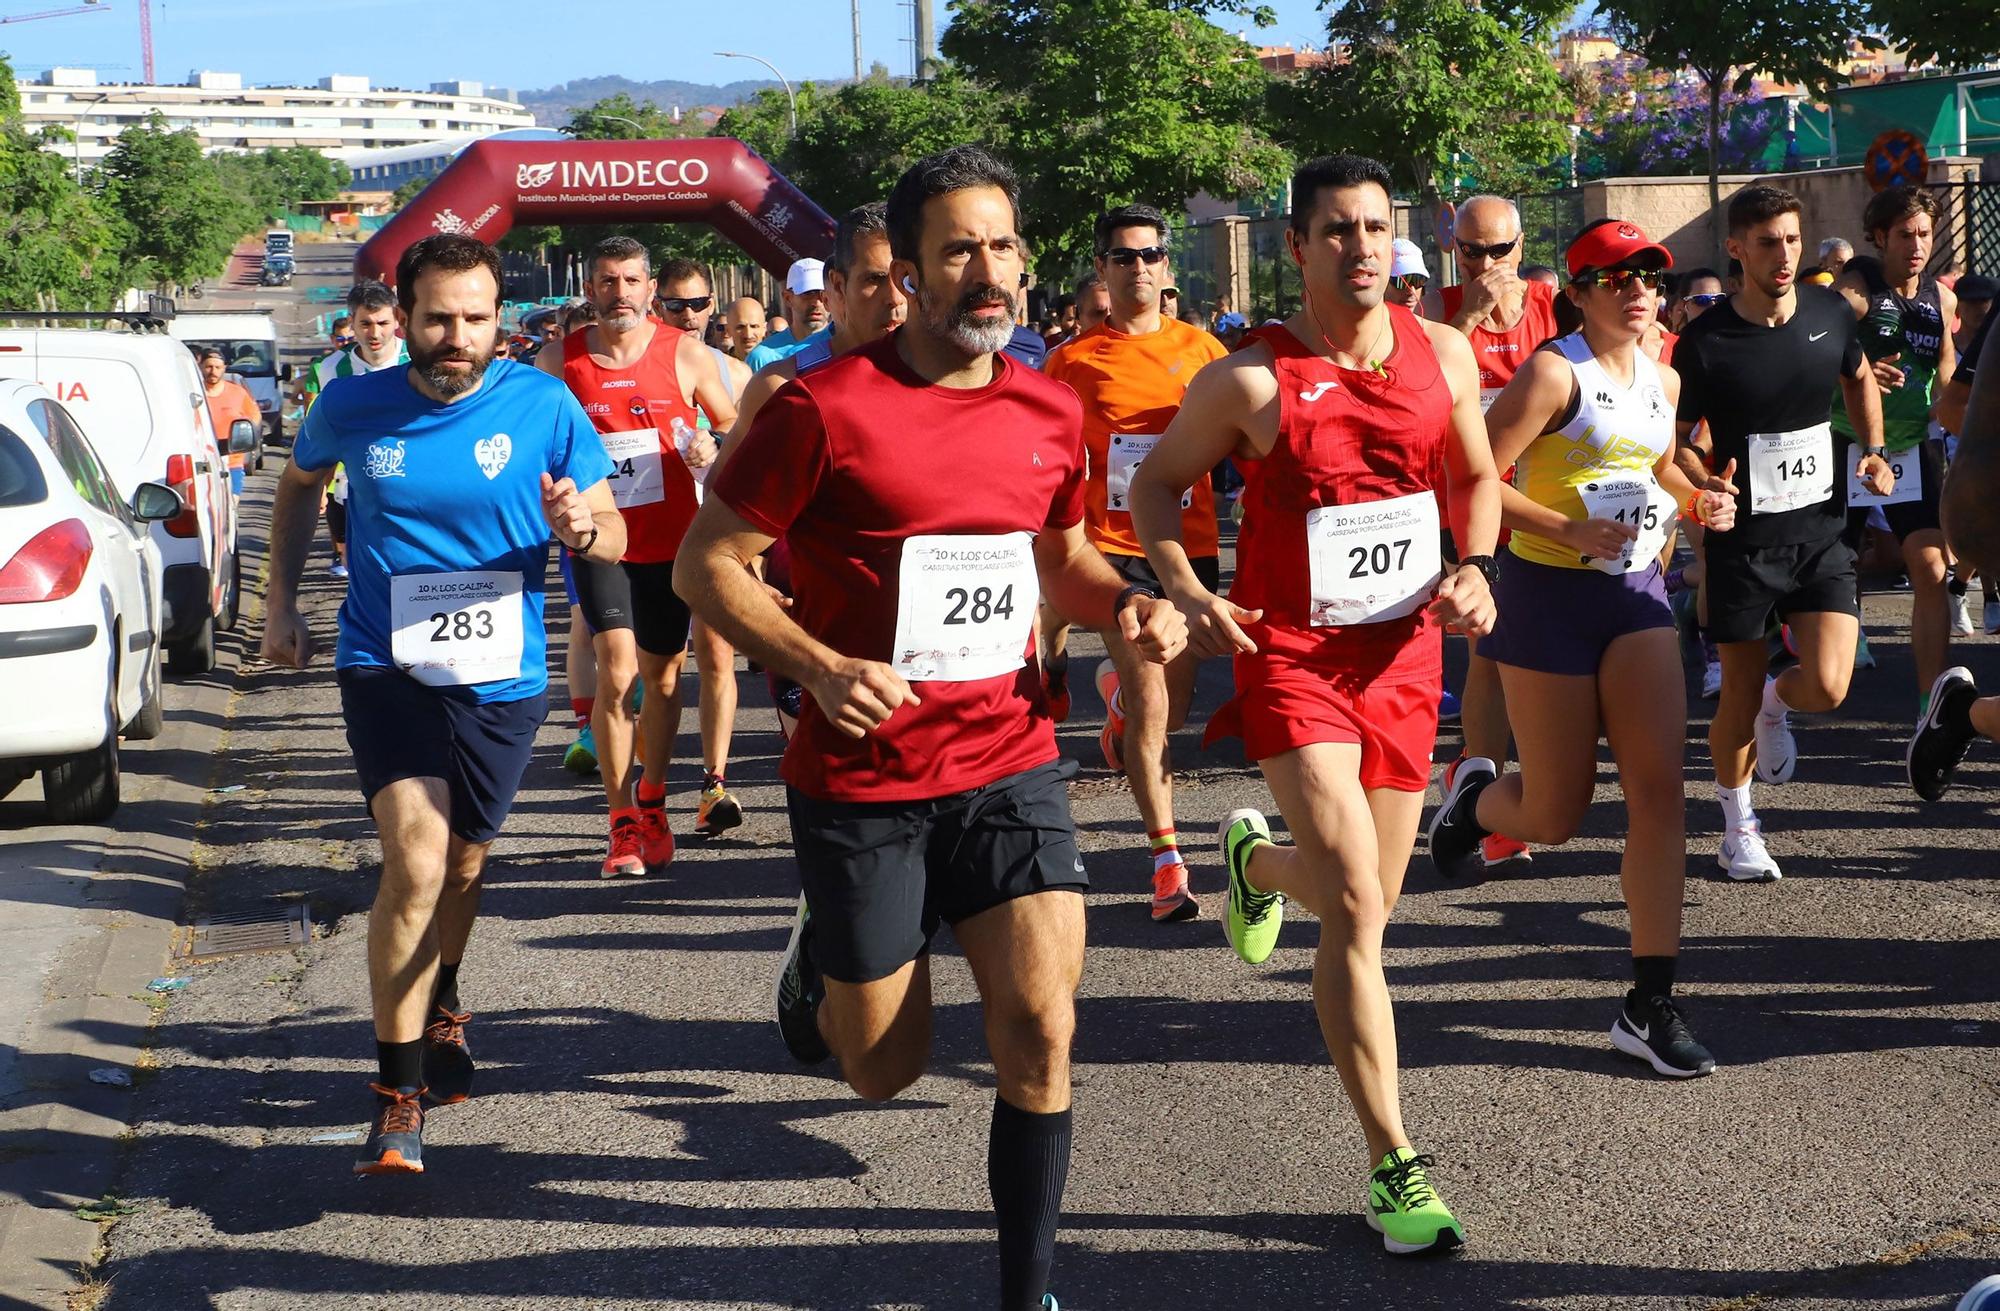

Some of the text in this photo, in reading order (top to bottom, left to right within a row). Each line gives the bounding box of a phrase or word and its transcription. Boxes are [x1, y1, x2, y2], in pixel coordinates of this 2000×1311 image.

[561, 159, 709, 188] IMDECO
[518, 191, 708, 203] Instituto Municipal de Deportes Córdoba
[582, 403, 611, 413] alifas
[1777, 455, 1817, 481] 143
[1336, 509, 1411, 526] 10 K LOS CALIFAS
[1614, 504, 1657, 531] 115
[935, 550, 948, 560] 10
[950, 551, 959, 560] K
[961, 551, 982, 561] LOS
[1348, 539, 1411, 579] 207
[418, 585, 430, 593] 10
[440, 583, 457, 592] LOS
[458, 582, 494, 591] CALIFAS
[943, 584, 1014, 625] 284
[430, 610, 494, 642] 283
